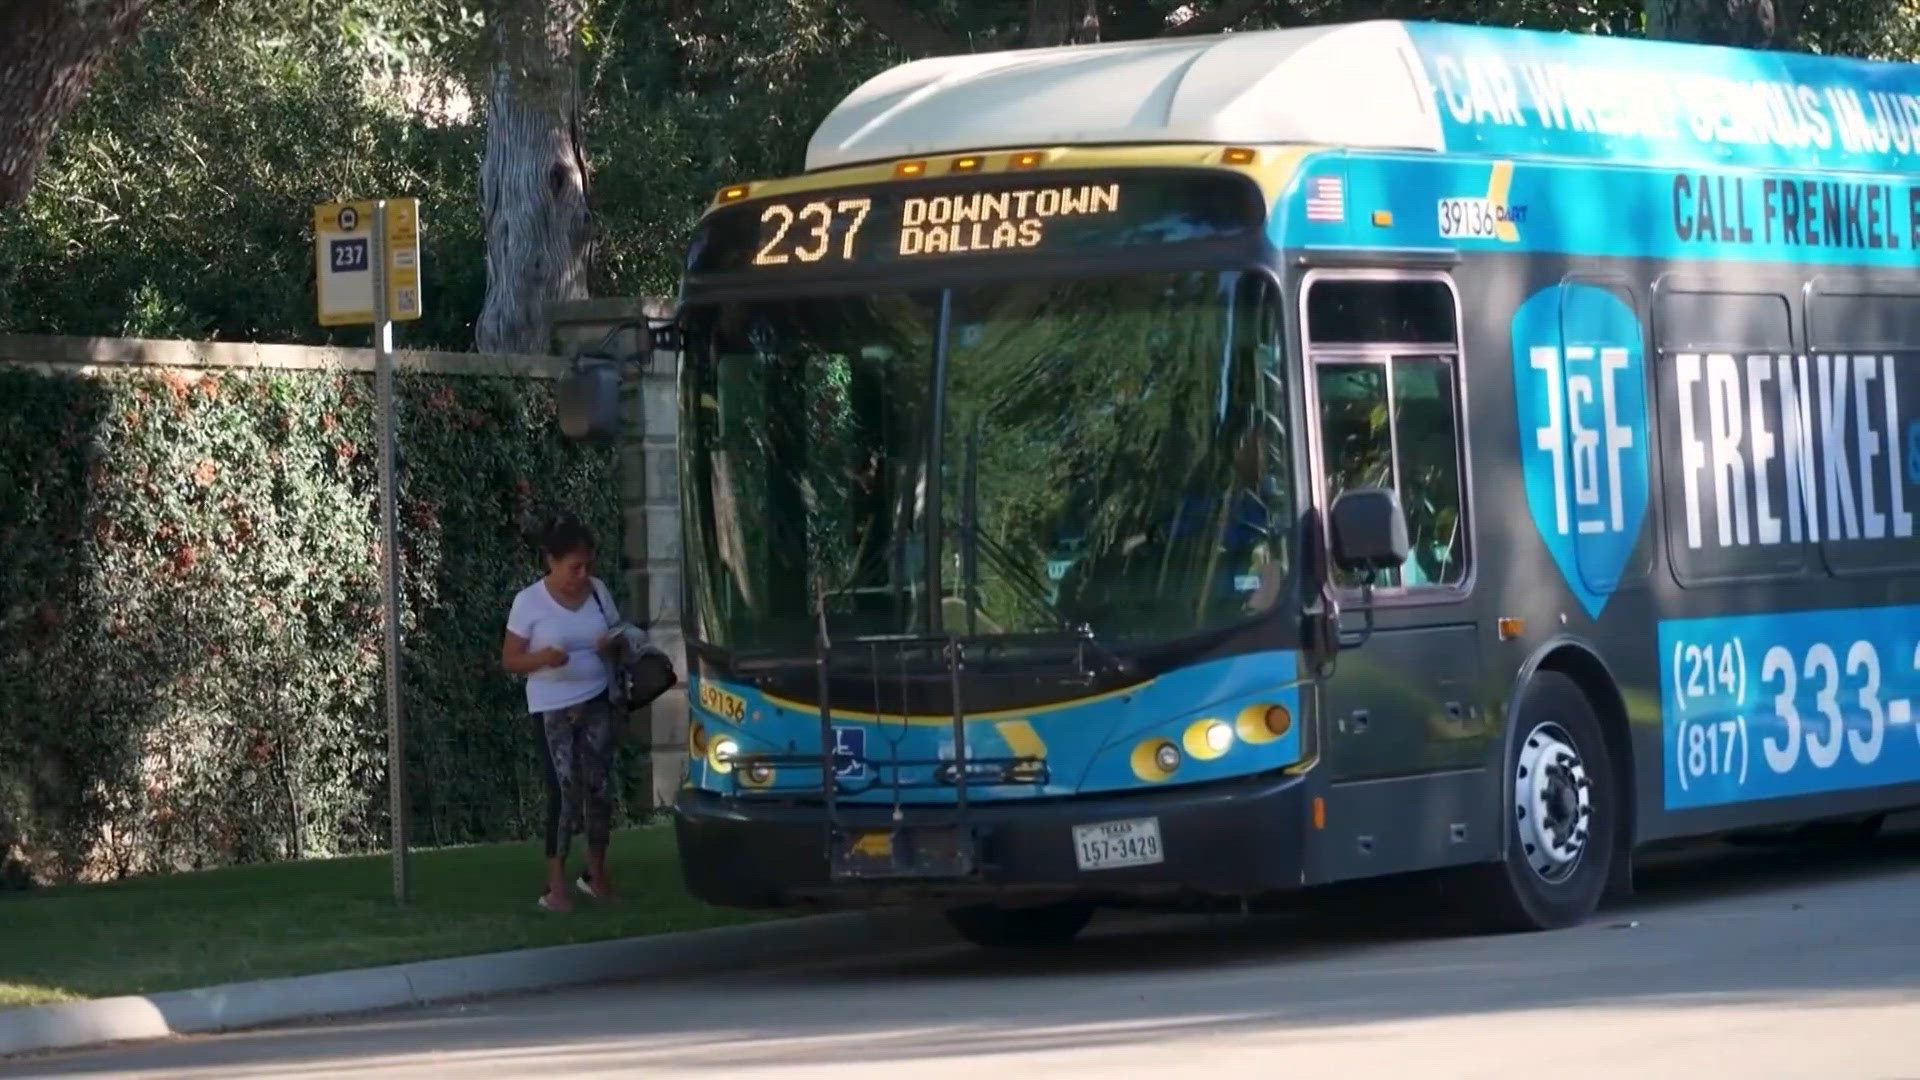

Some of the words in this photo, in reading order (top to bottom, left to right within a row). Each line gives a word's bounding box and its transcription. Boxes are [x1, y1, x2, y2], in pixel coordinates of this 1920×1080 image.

[1436, 56, 1526, 127] CAR
[752, 199, 871, 265] 237
[899, 218, 1043, 256] DALLAS
[902, 184, 1119, 227] DOWNTOWN
[1441, 200, 1493, 236] 39136
[1673, 173, 1753, 243] CALL
[1763, 178, 1899, 249] FRENKEL
[335, 245, 364, 266] 237
[1676, 353, 1912, 548] FRENKEL
[1673, 636, 1746, 710] (214)
[1677, 714, 1749, 792] (817)
[1101, 822, 1134, 835] TEXAS
